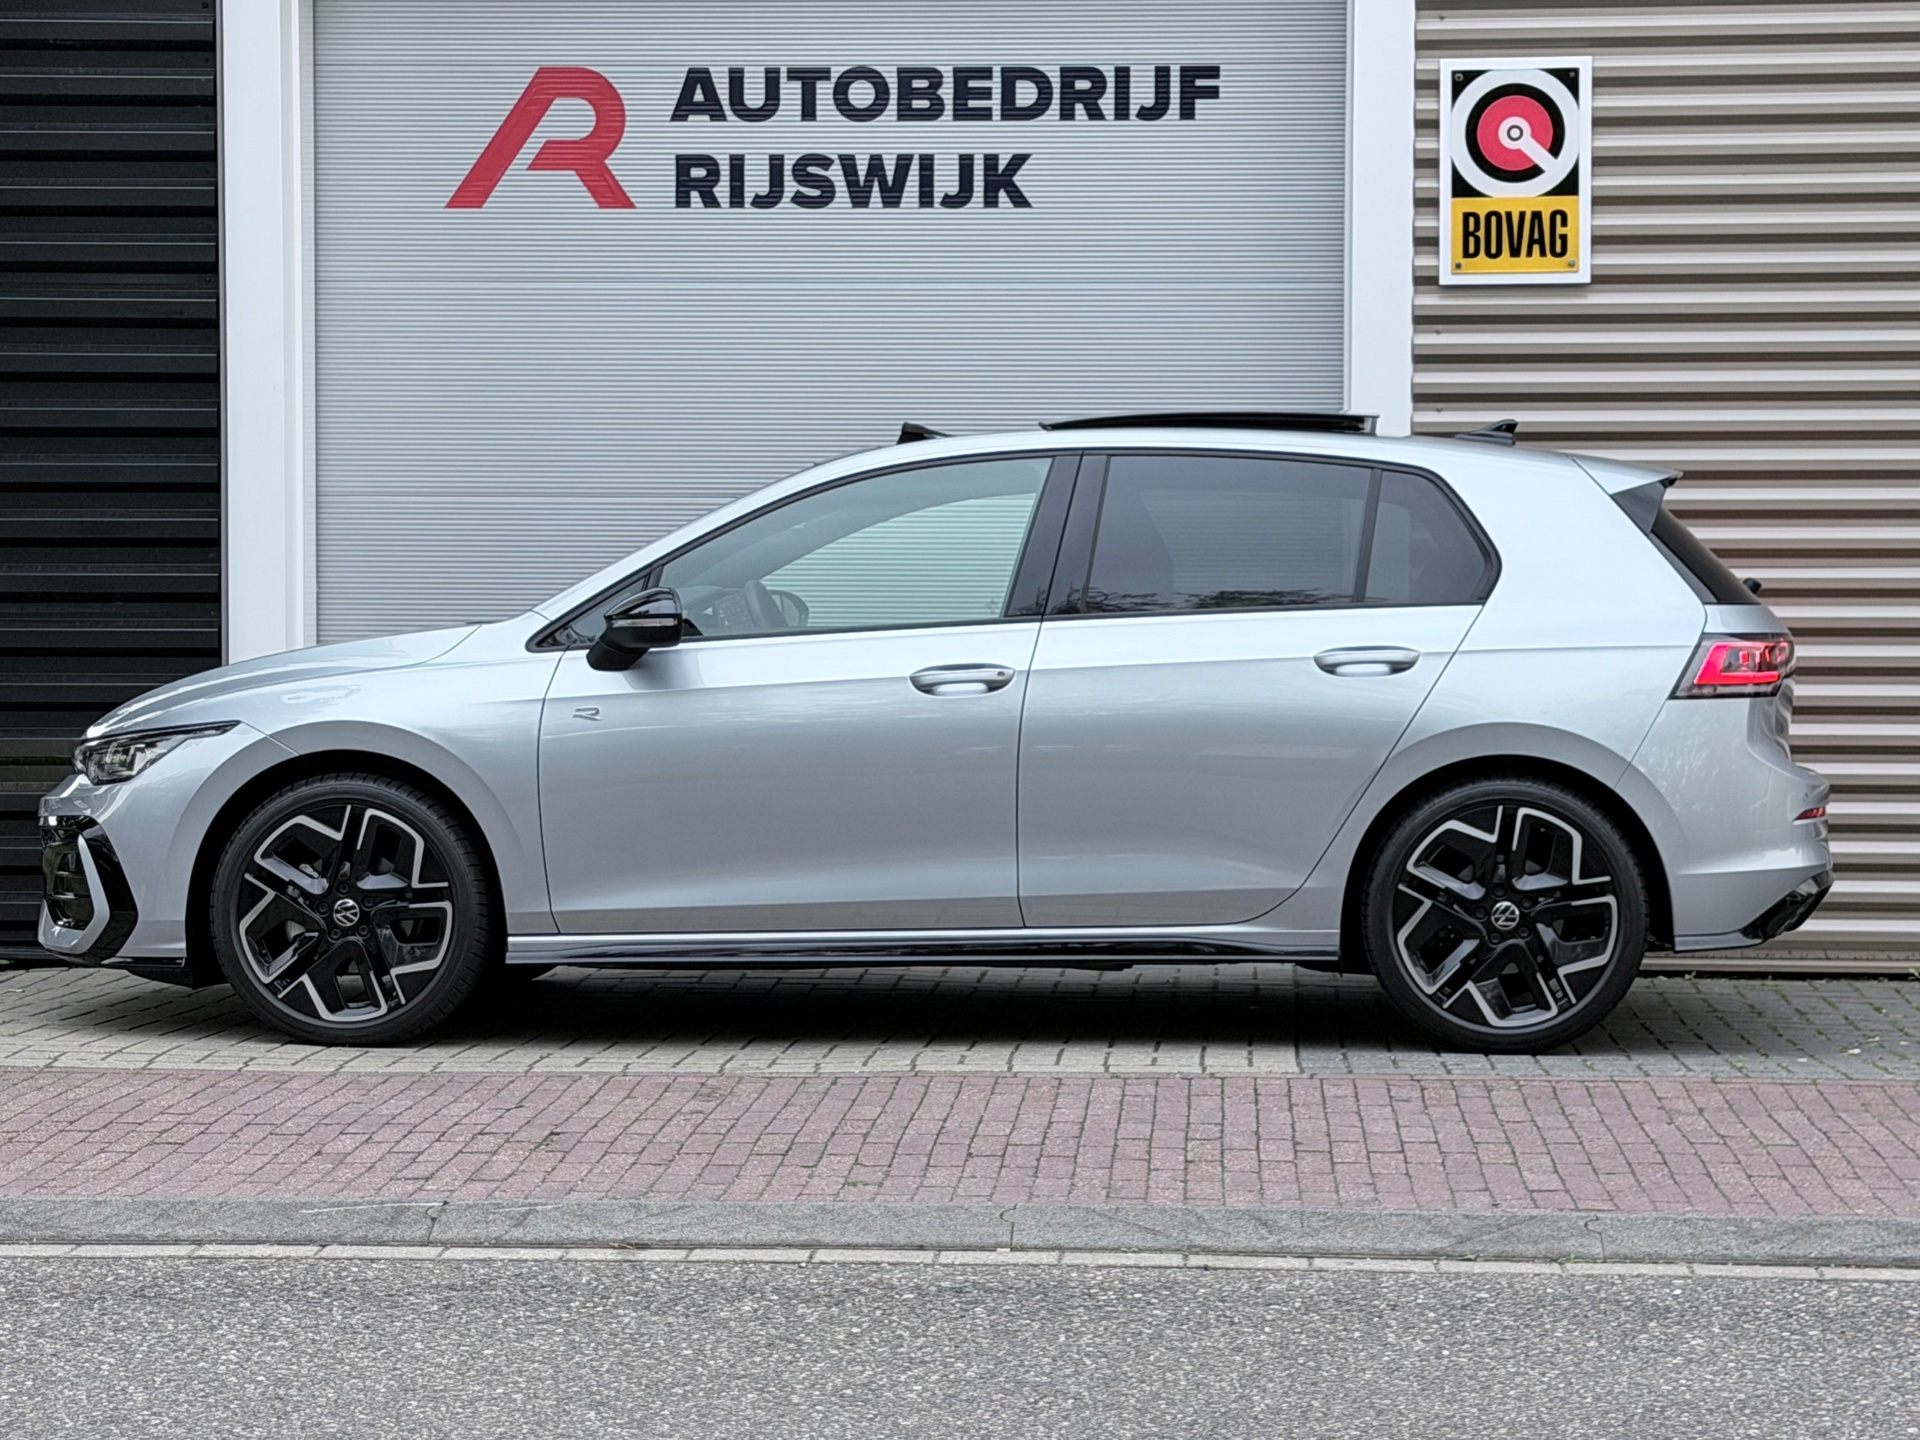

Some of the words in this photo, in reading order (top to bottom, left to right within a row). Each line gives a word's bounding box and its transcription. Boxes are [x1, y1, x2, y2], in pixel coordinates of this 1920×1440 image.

[670, 65, 1221, 122] AUTOBEDRIJF
[675, 153, 1033, 209] RIJSWIJK
[1462, 209, 1568, 259] BOVAG
